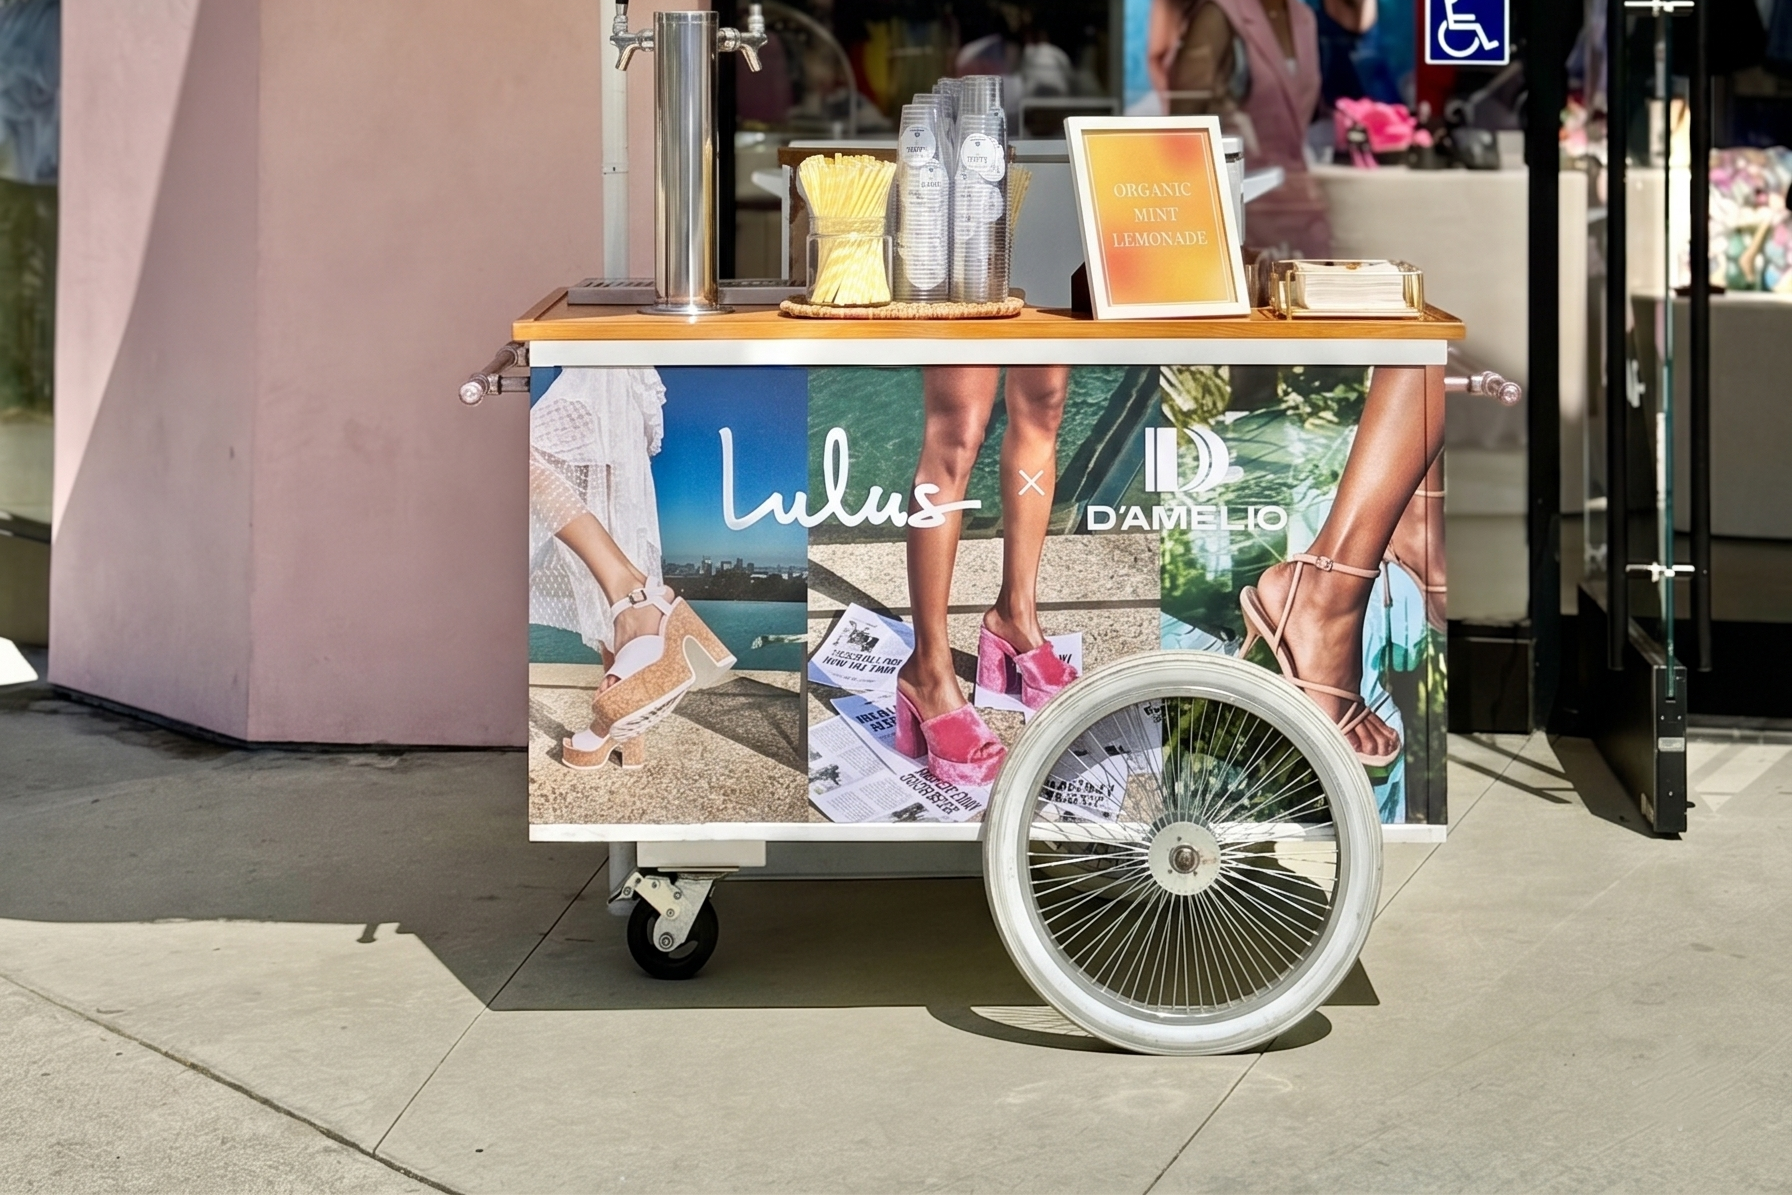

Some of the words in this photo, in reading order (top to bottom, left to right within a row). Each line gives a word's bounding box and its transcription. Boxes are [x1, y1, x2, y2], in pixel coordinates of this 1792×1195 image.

[1113, 181, 1192, 198] ORGANIC
[1133, 206, 1179, 223] MINT
[1112, 230, 1208, 248] LEMONADE
[718, 426, 982, 531] Lulus
[1086, 505, 1289, 532] D'AMELIO
